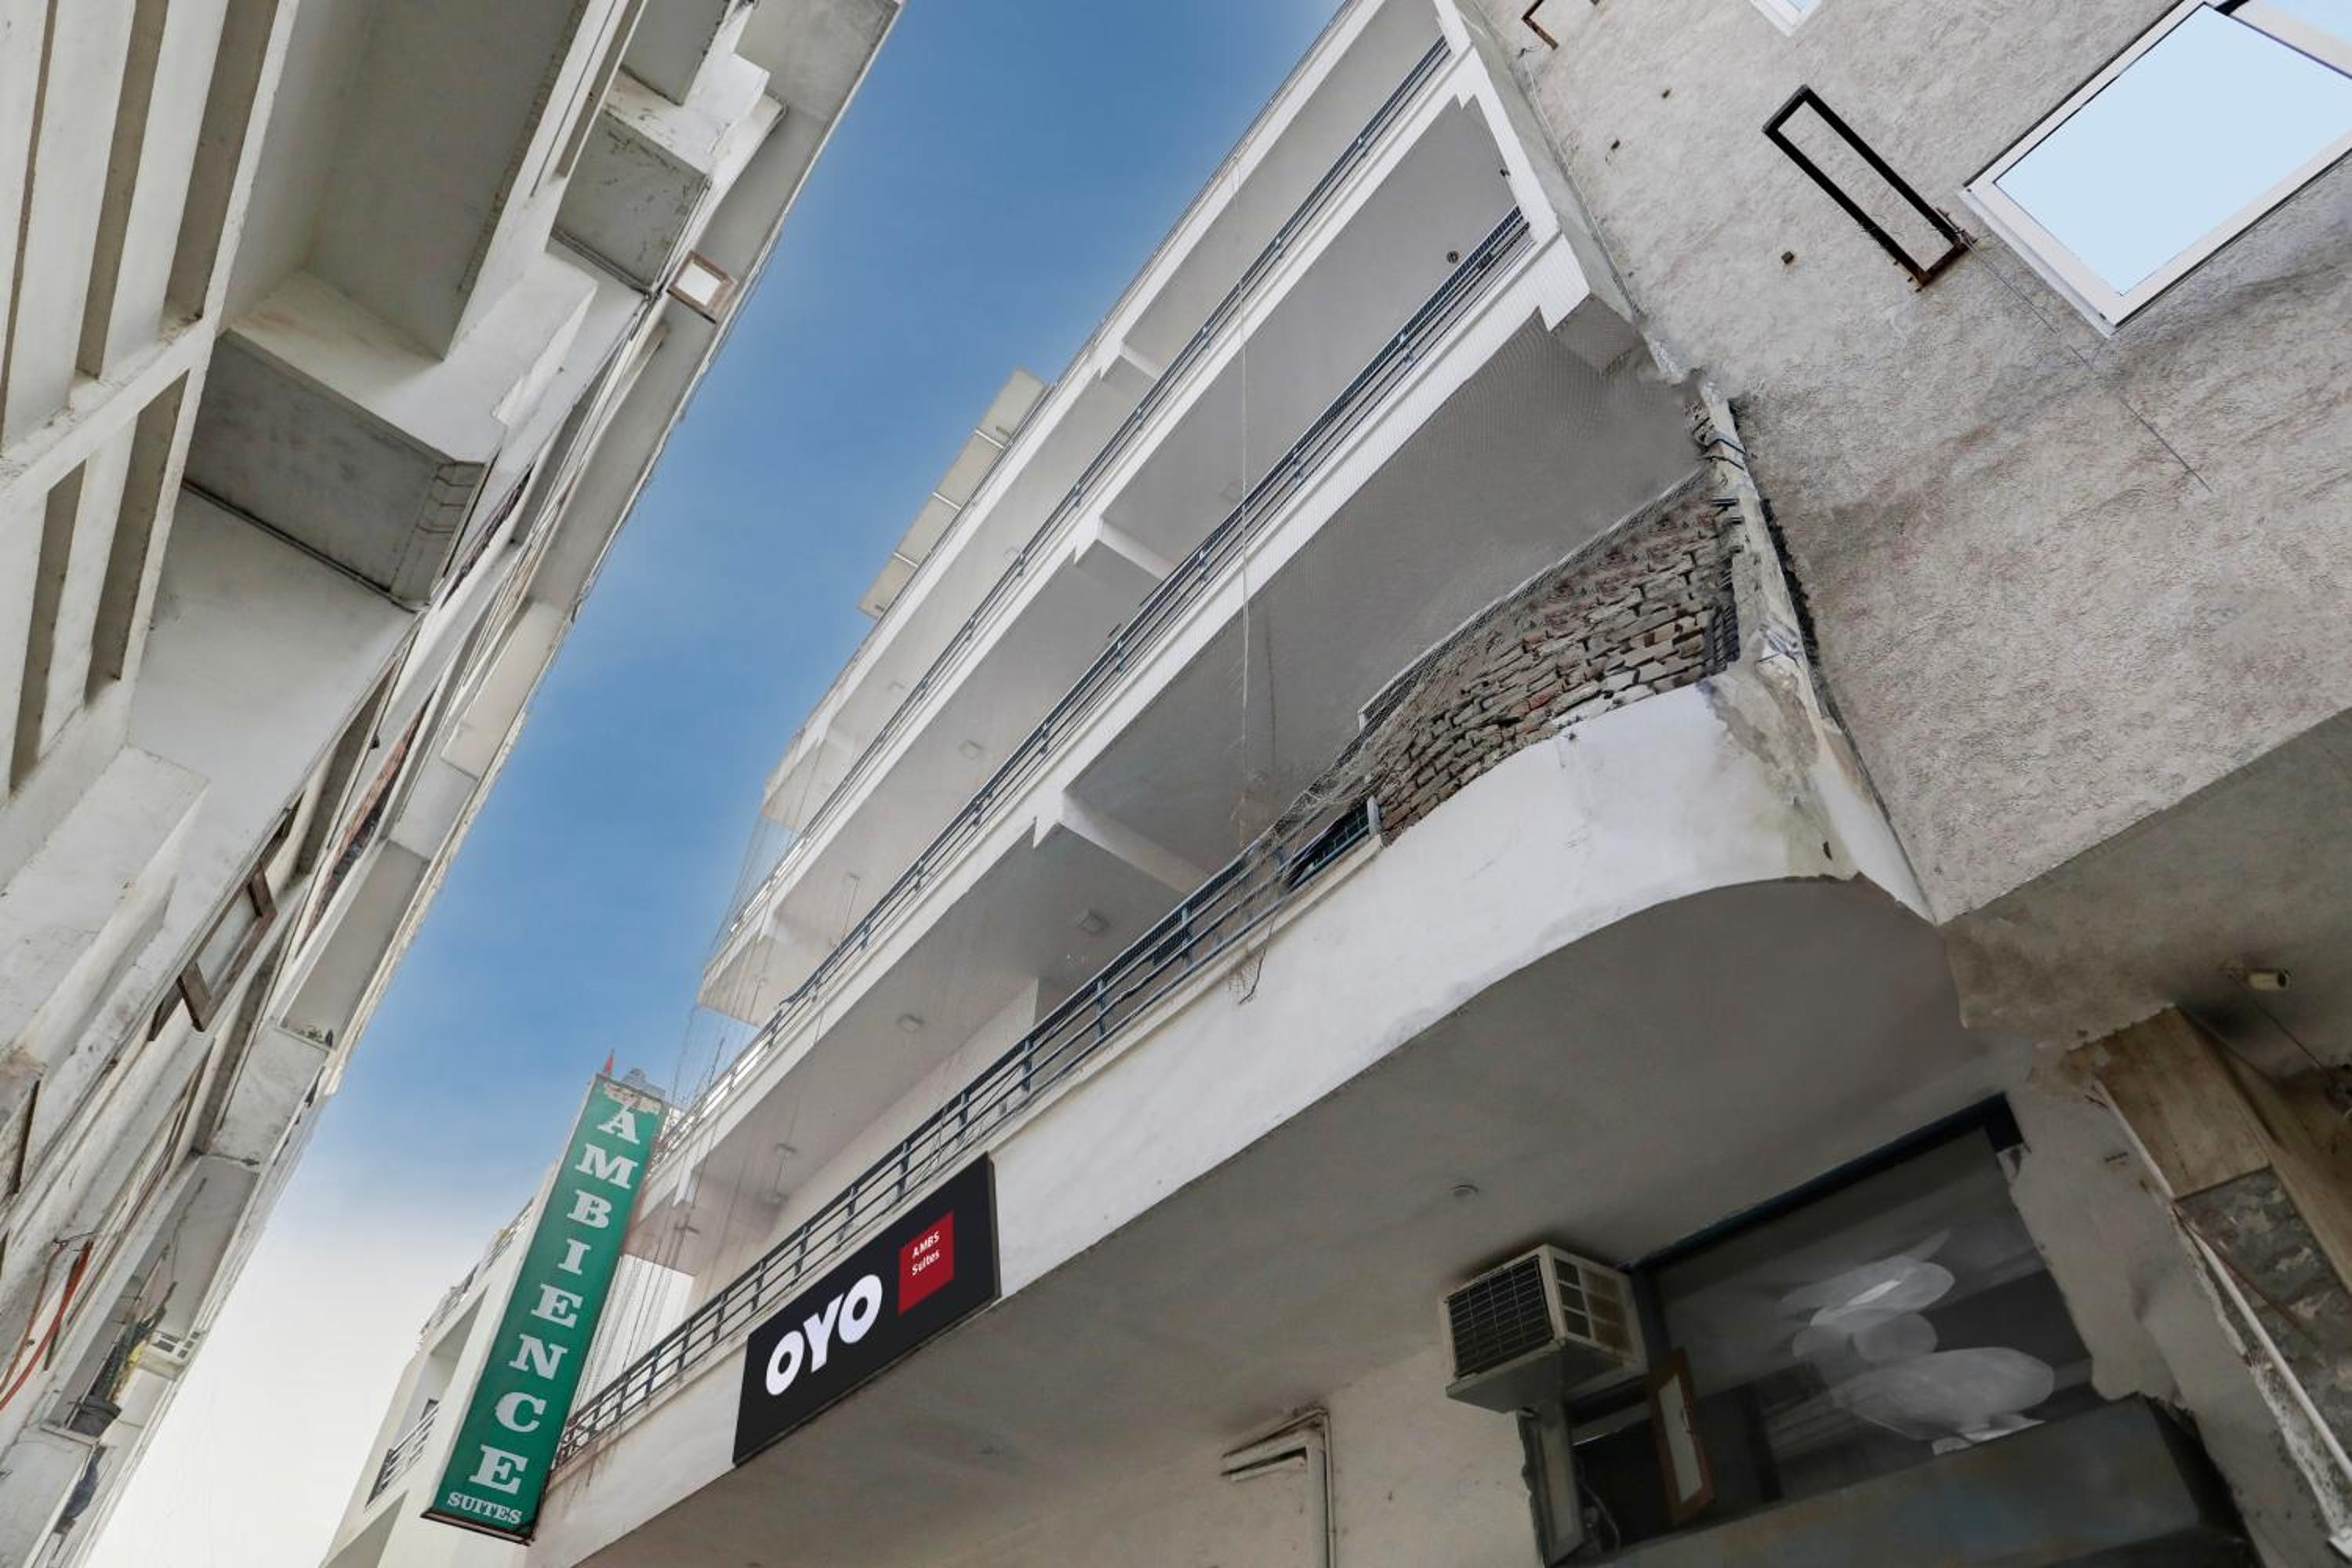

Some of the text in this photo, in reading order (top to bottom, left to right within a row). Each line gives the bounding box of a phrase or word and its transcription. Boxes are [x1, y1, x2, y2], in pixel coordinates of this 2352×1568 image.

[469, 1104, 641, 1494] AMBIENCE
[912, 1249, 940, 1276] Suites
[766, 1275, 883, 1396] OYO
[447, 1492, 522, 1524] SUITES
